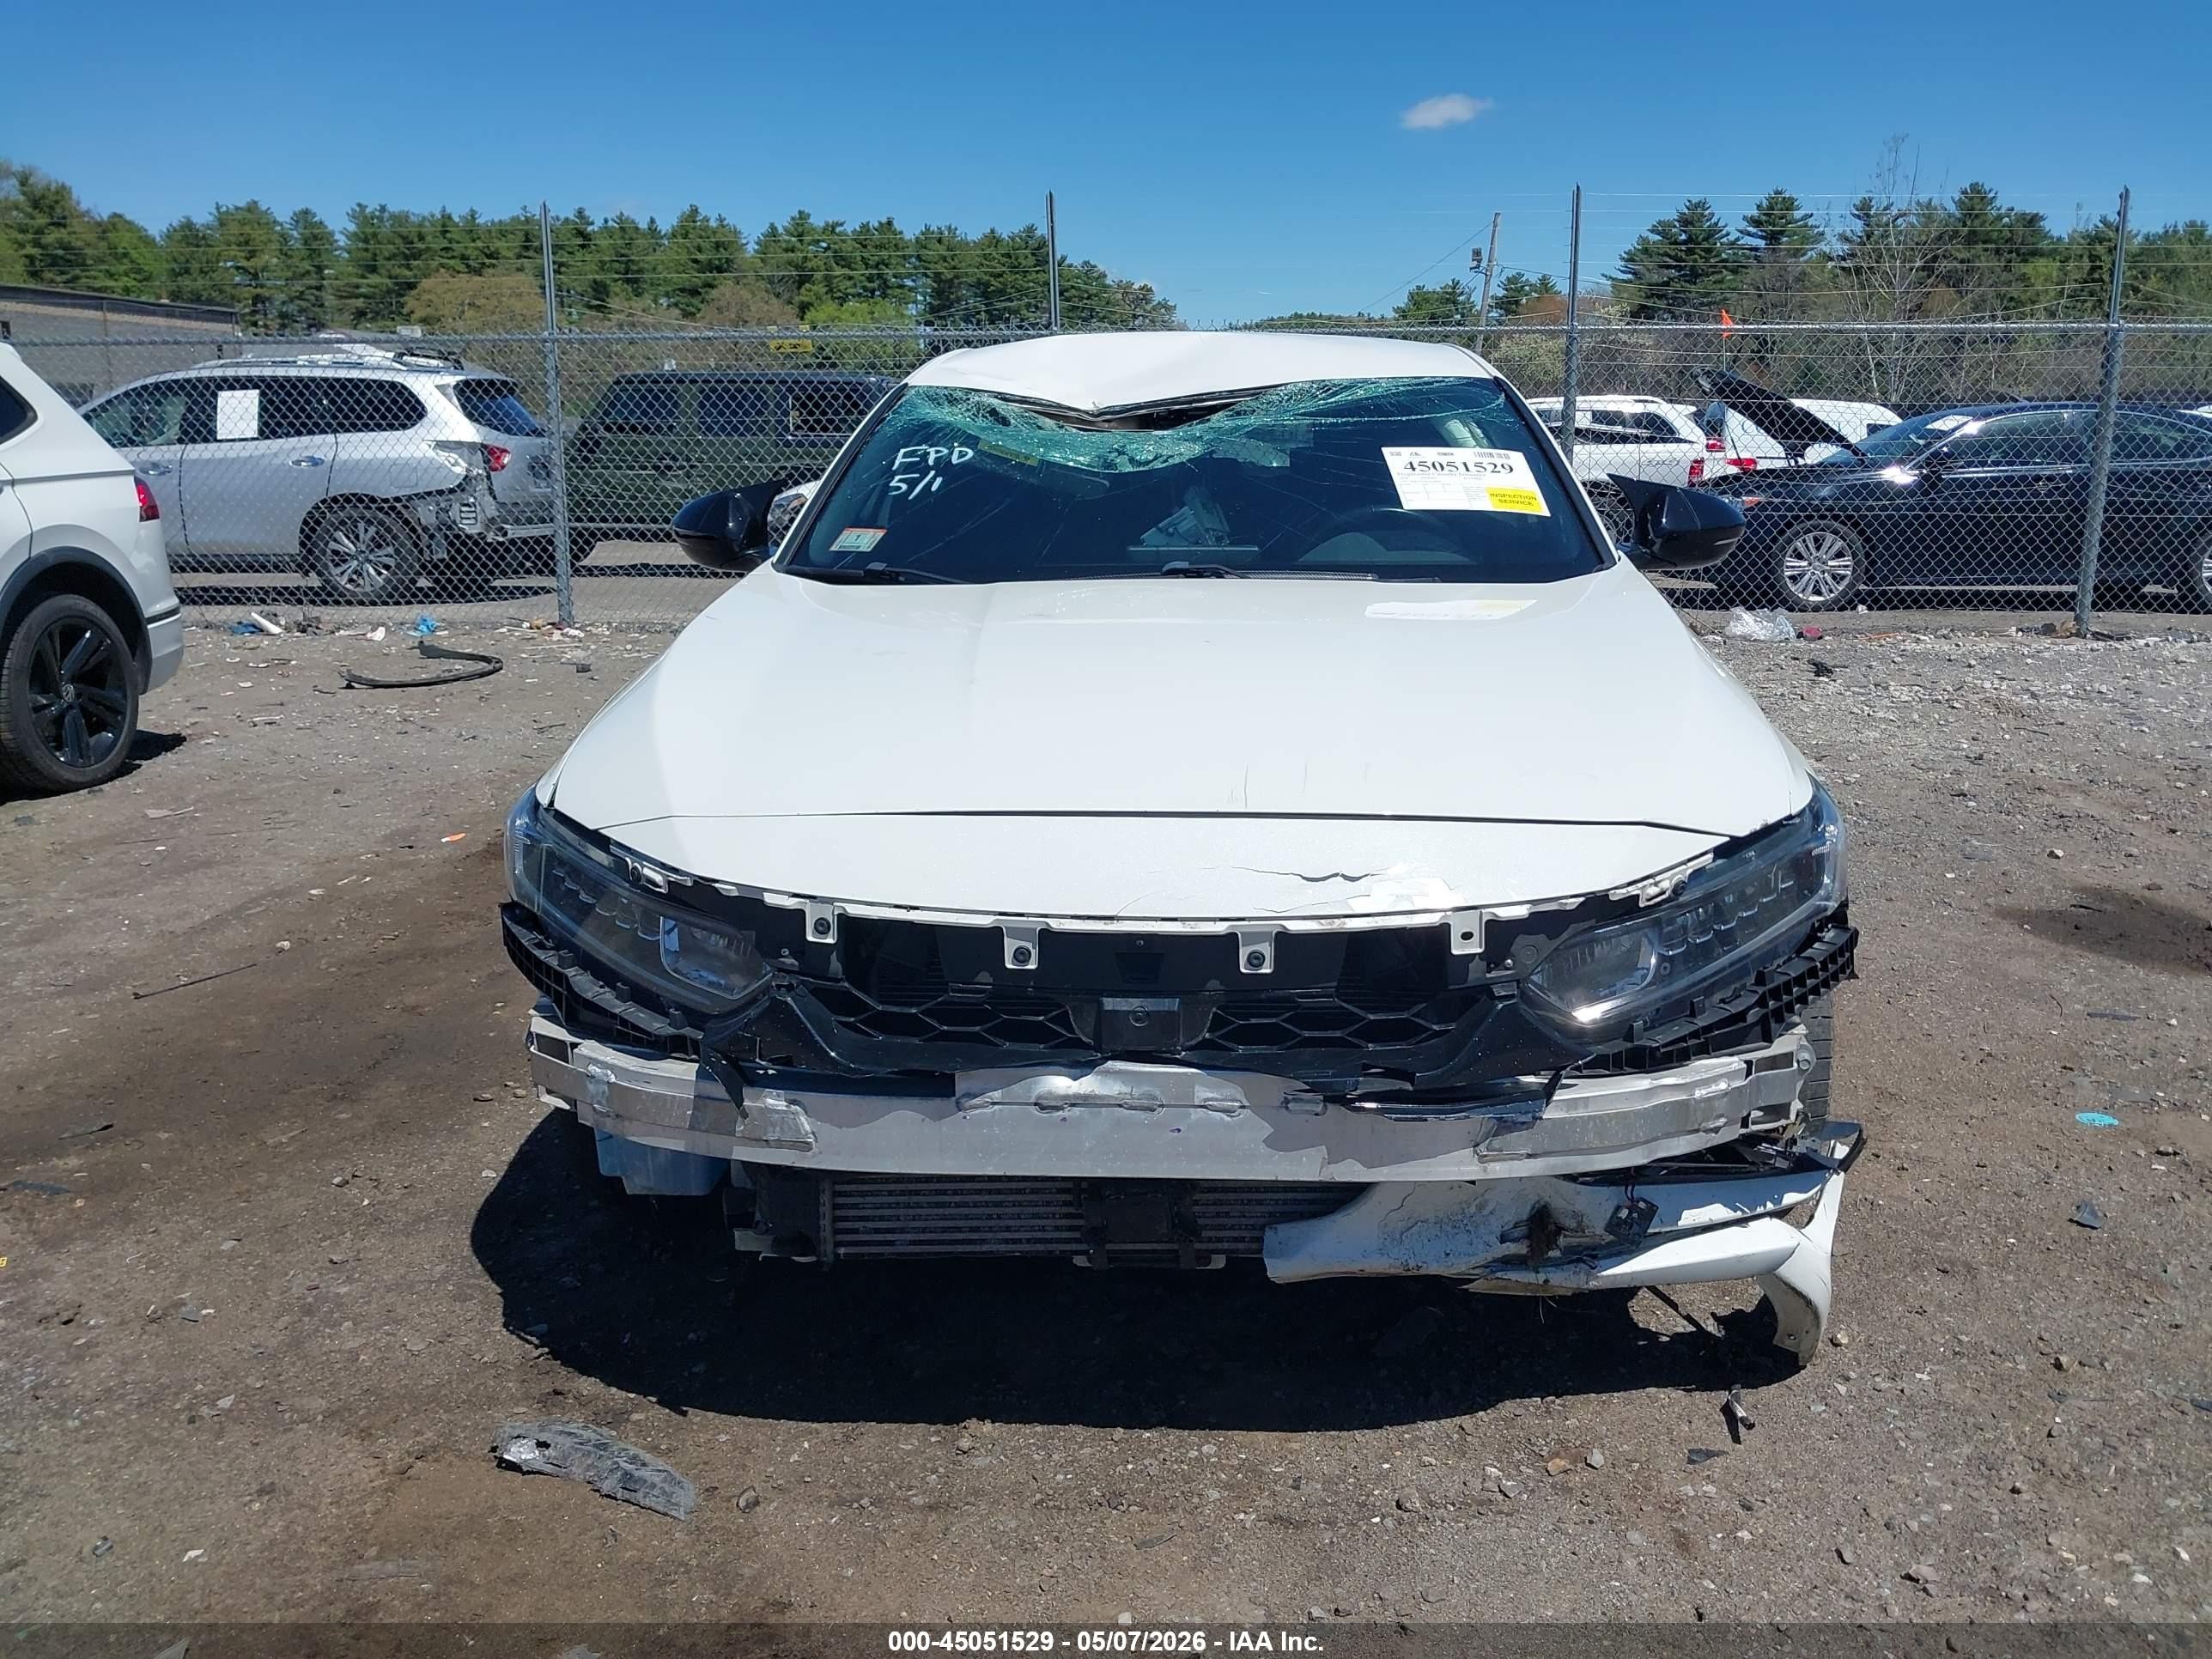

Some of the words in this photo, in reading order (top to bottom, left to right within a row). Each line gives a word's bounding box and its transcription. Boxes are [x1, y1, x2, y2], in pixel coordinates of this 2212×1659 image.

[1403, 461, 1514, 475] 45051529
[888, 471, 943, 500] 5/1
[1489, 493, 1537, 501] INSPECTION
